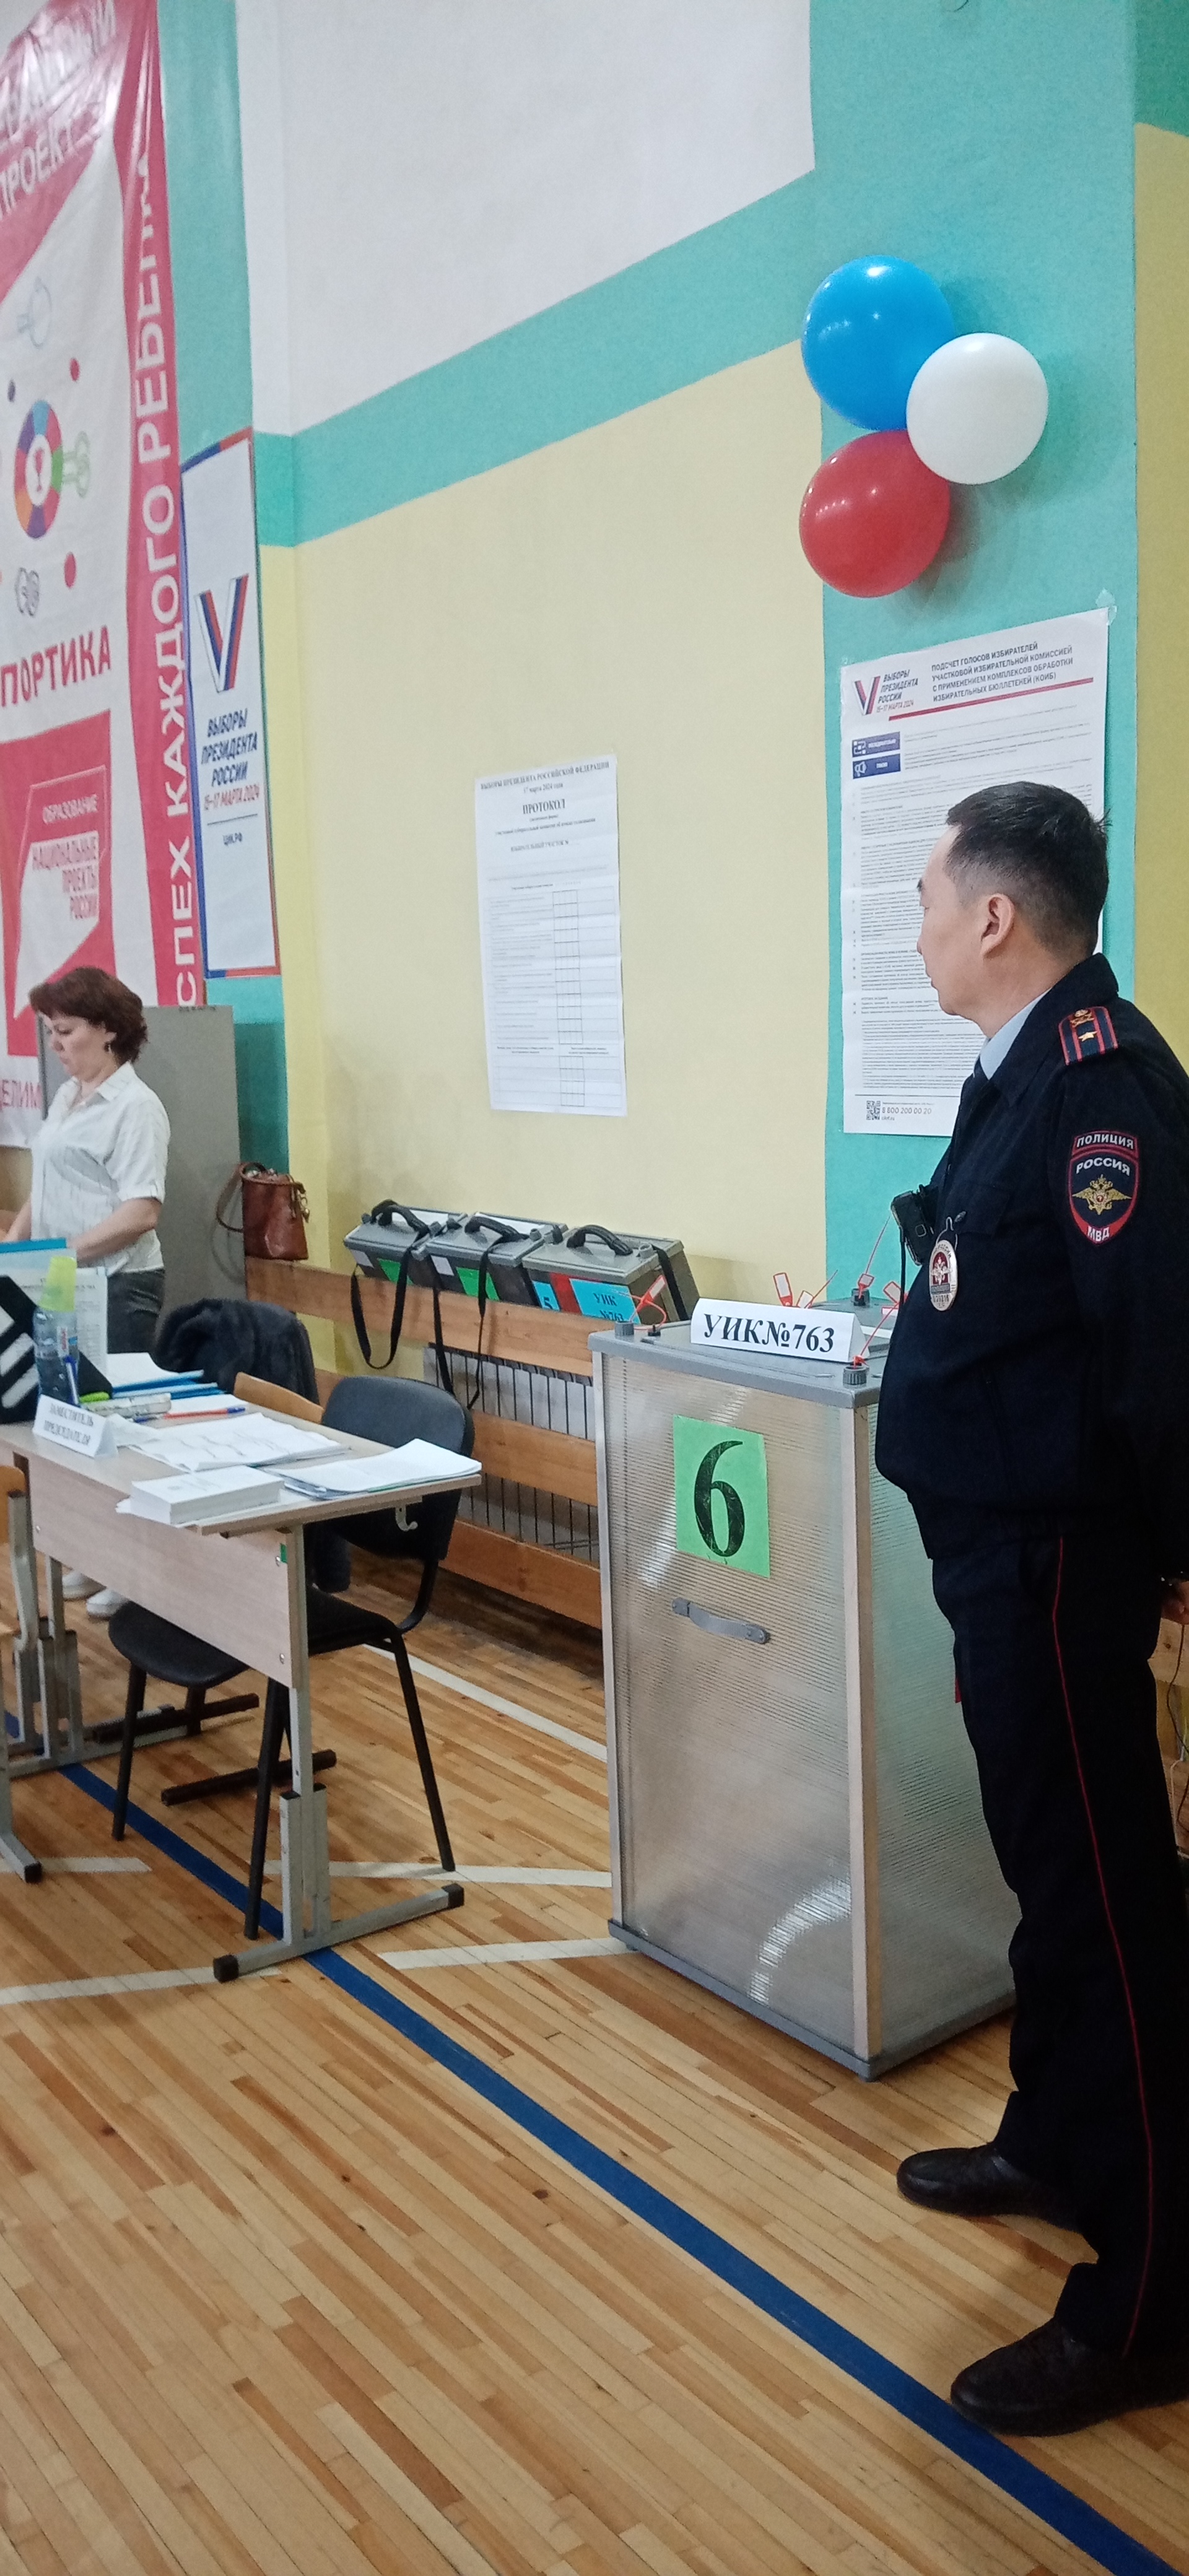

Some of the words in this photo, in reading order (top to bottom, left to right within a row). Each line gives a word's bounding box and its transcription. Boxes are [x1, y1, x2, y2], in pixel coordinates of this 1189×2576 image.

[142, 484, 189, 817] КАЖДОГО
[931, 659, 959, 672] ПОДСЧЕТ
[960, 653, 990, 665] ГОЛОСОВ
[991, 642, 1038, 658] ИЗБИРАТЕЛЕЙ
[931, 666, 972, 682] УЧАСТКОВОЙ
[973, 654, 1029, 674] ИЗБИРАТЕЛЬНОЙ
[1030, 645, 1073, 661] КОМИССИЕЙ
[881, 678, 918, 693] ПРЕЗИДЕНТА
[883, 669, 910, 682] ВЫБОРЫ
[933, 684, 987, 702] ИЗБИРАТЕЛЬНЫХ
[988, 676, 1032, 691] БЮЛЛЕТЕНЕЙ
[1033, 672, 1056, 684] (КОИБ)
[938, 676, 986, 690] ПРИМЕНЕНИЕМ
[987, 666, 1032, 681] КОМПЛЕКСОВ
[1034, 658, 1073, 672] ОБРАБОТКИ
[878, 692, 902, 703] РОССИИ
[207, 708, 248, 738] ВЫБОРЫ
[201, 731, 258, 764] ПРЕЗИДЕНТА
[211, 761, 248, 786] РОССИИ
[523, 798, 565, 814] ПРОТОКОЛ
[1076, 1134, 1134, 1149] ПОЛИЦИЯ
[1076, 1157, 1130, 1176] РОССИЯ
[1087, 1225, 1110, 1242] МВД
[593, 1293, 617, 1307] УИК
[703, 1313, 835, 1352] УИК№763
[694, 1440, 745, 1557] 6
